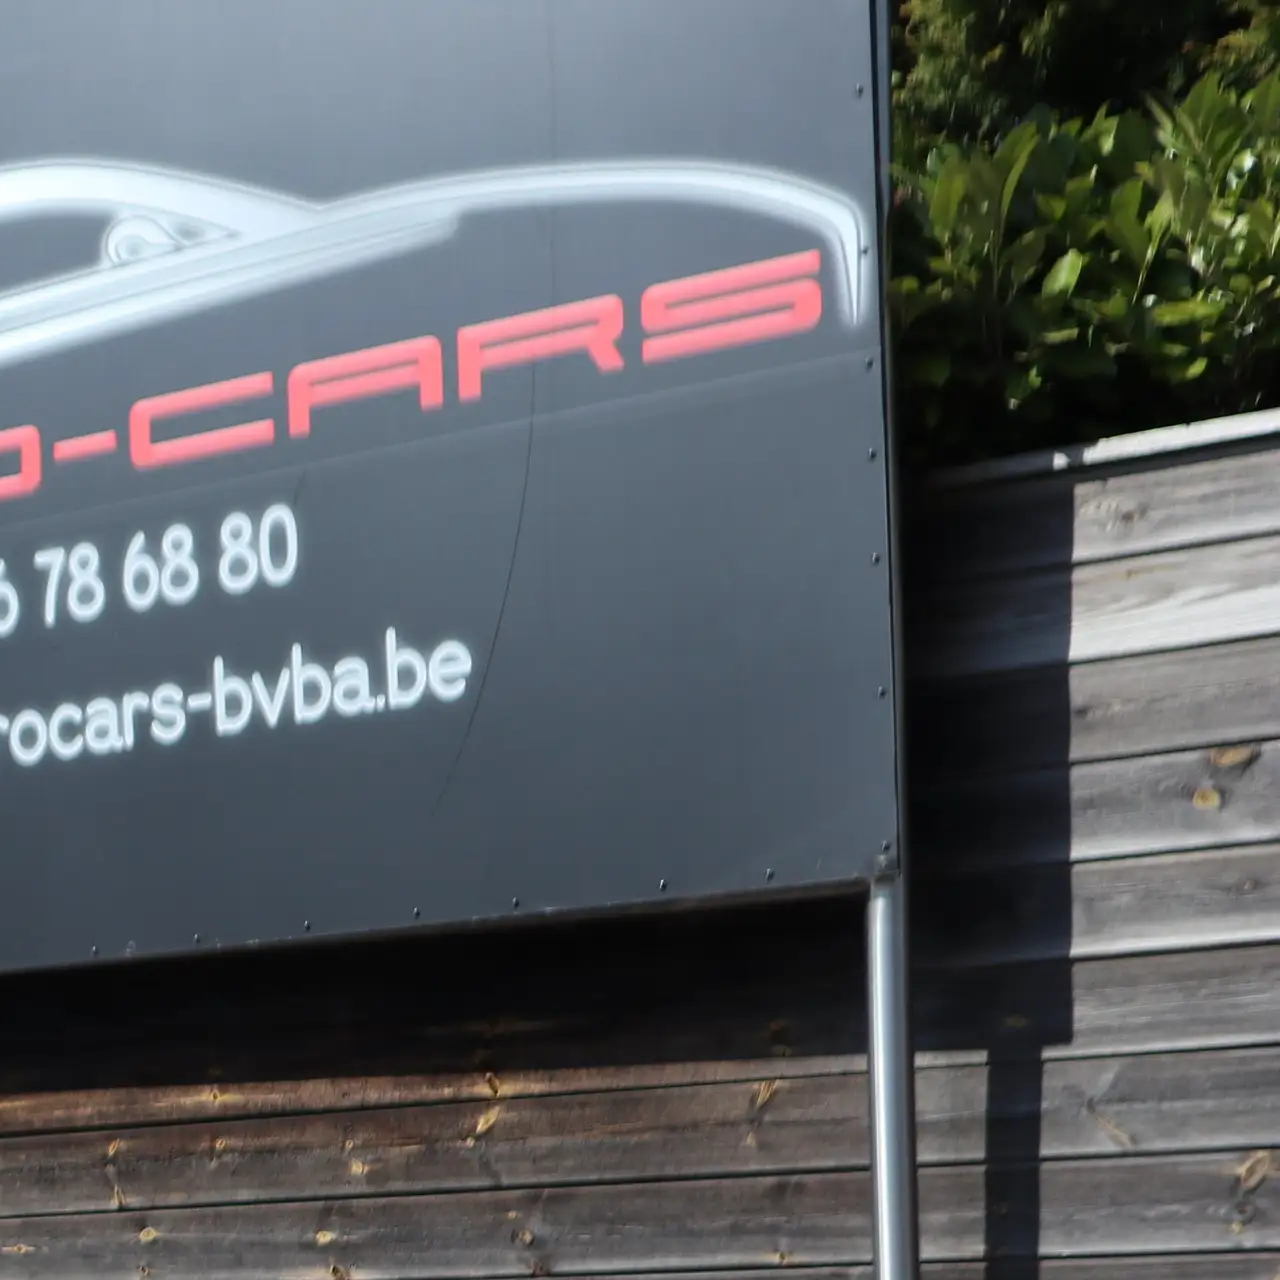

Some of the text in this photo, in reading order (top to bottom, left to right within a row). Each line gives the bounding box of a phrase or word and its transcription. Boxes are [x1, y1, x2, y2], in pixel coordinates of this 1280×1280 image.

[33, 541, 107, 627] 78
[122, 522, 200, 612] 68
[218, 503, 300, 594] 80
